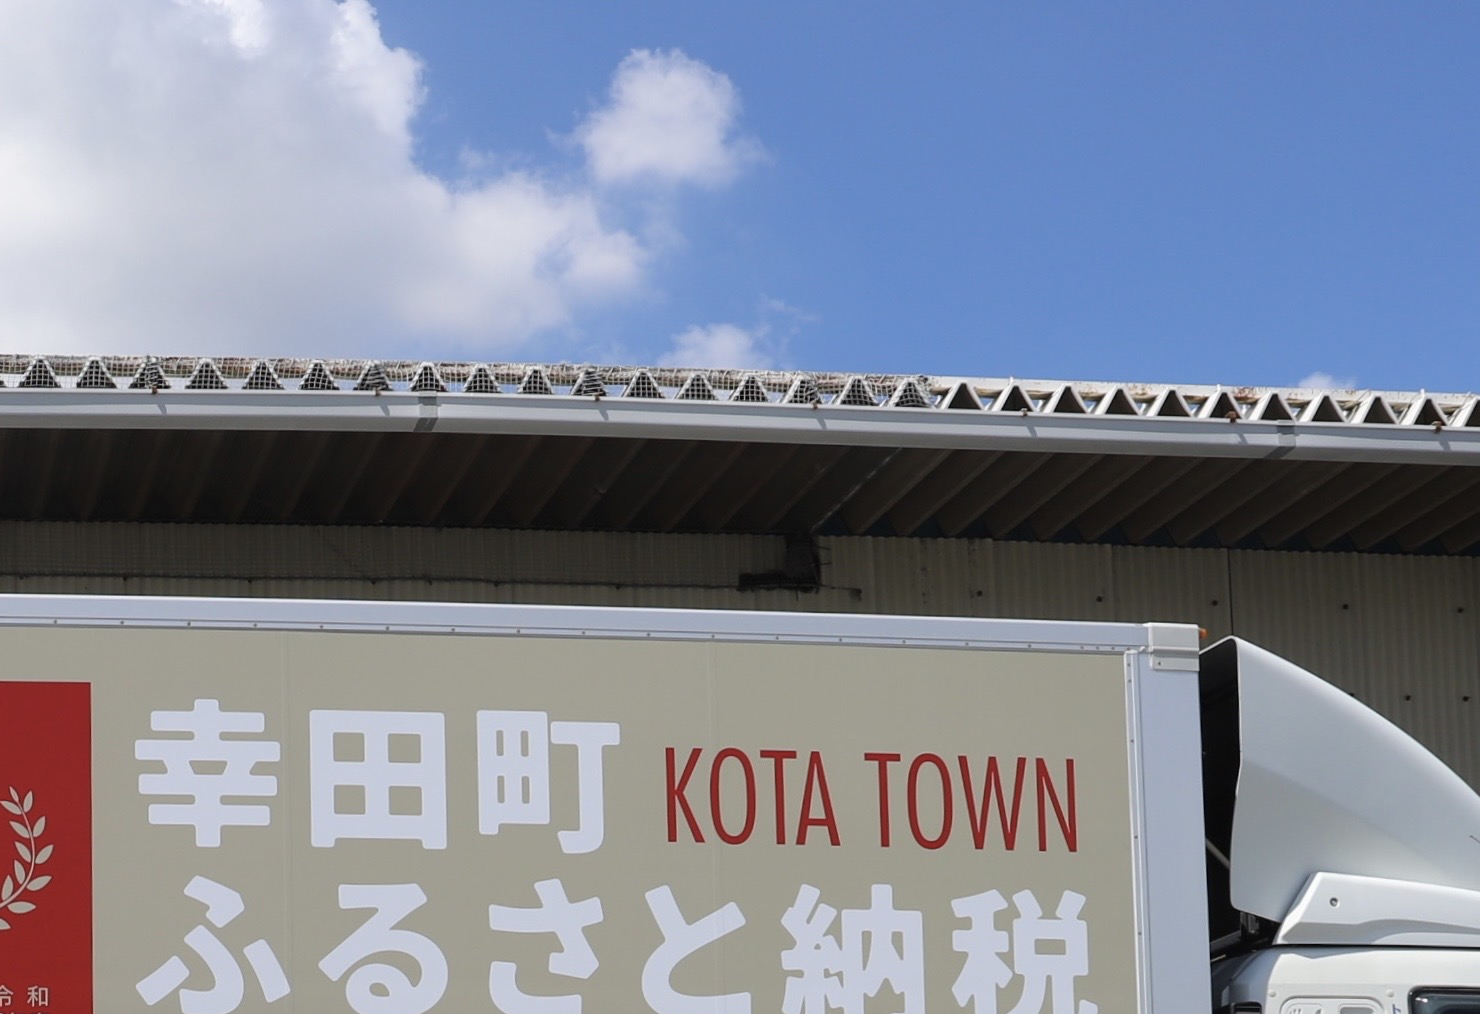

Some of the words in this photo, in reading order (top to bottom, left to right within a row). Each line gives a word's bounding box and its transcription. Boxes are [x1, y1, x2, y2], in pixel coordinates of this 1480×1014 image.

[134, 698, 621, 854] 幸田町
[664, 746, 841, 847] KOTA
[863, 751, 1078, 853] TOWN
